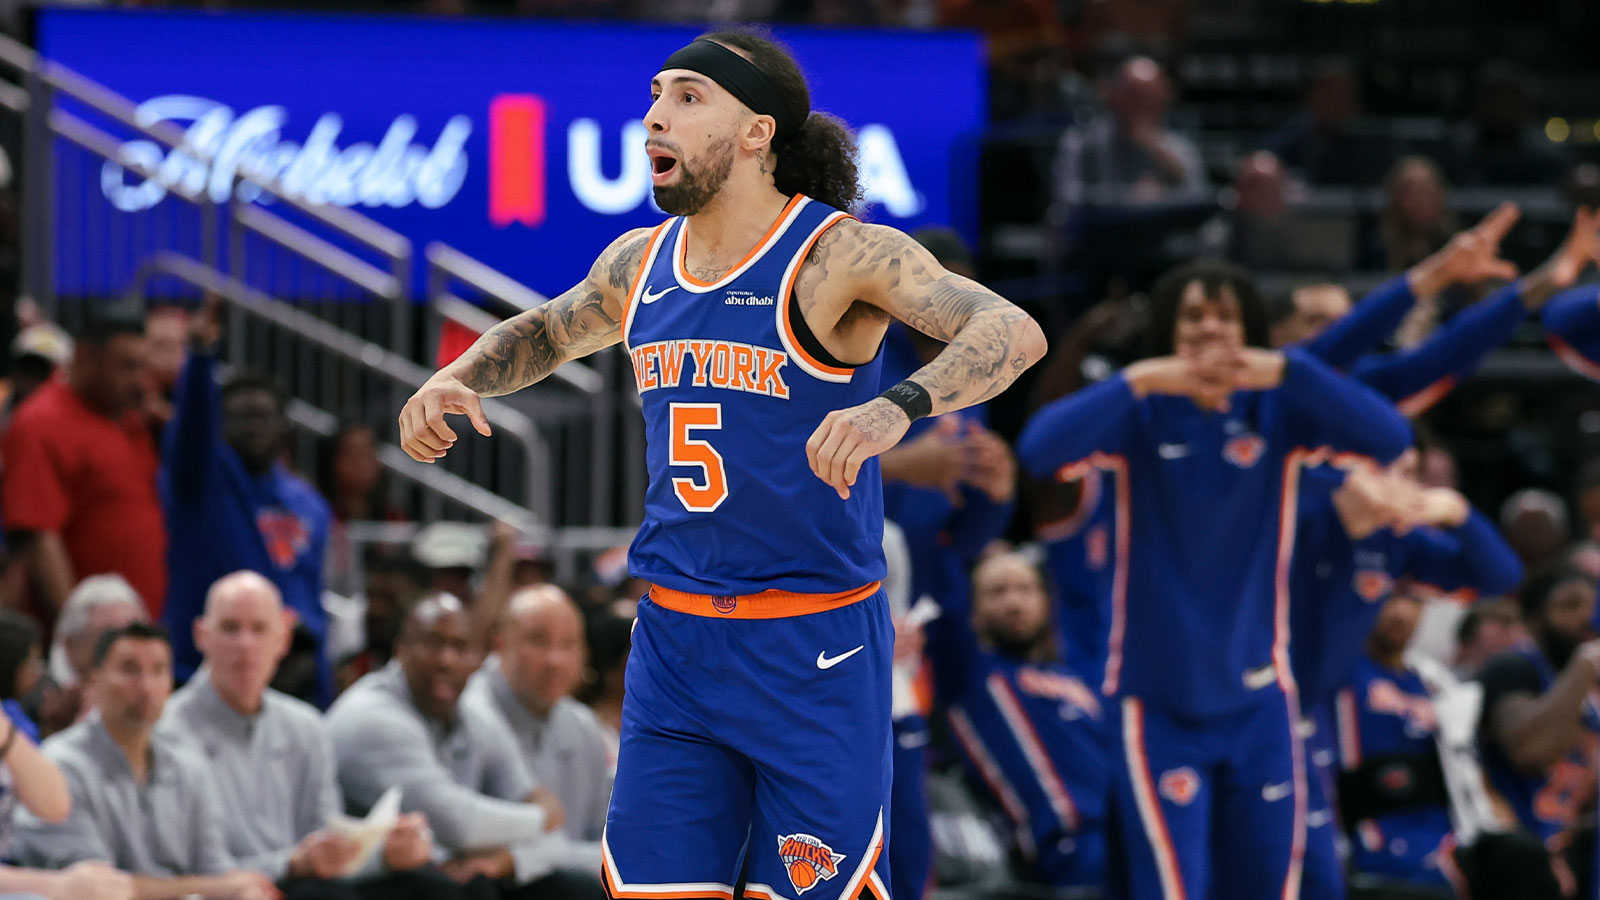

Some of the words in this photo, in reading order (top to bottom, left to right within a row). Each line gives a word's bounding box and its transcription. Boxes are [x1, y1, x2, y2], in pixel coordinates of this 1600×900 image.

[724, 295, 745, 306] abu
[745, 296, 774, 306] dhabi
[630, 339, 689, 396] NEW
[687, 338, 790, 400] YORK
[669, 403, 729, 512] 5
[780, 838, 834, 873] KNICKS
